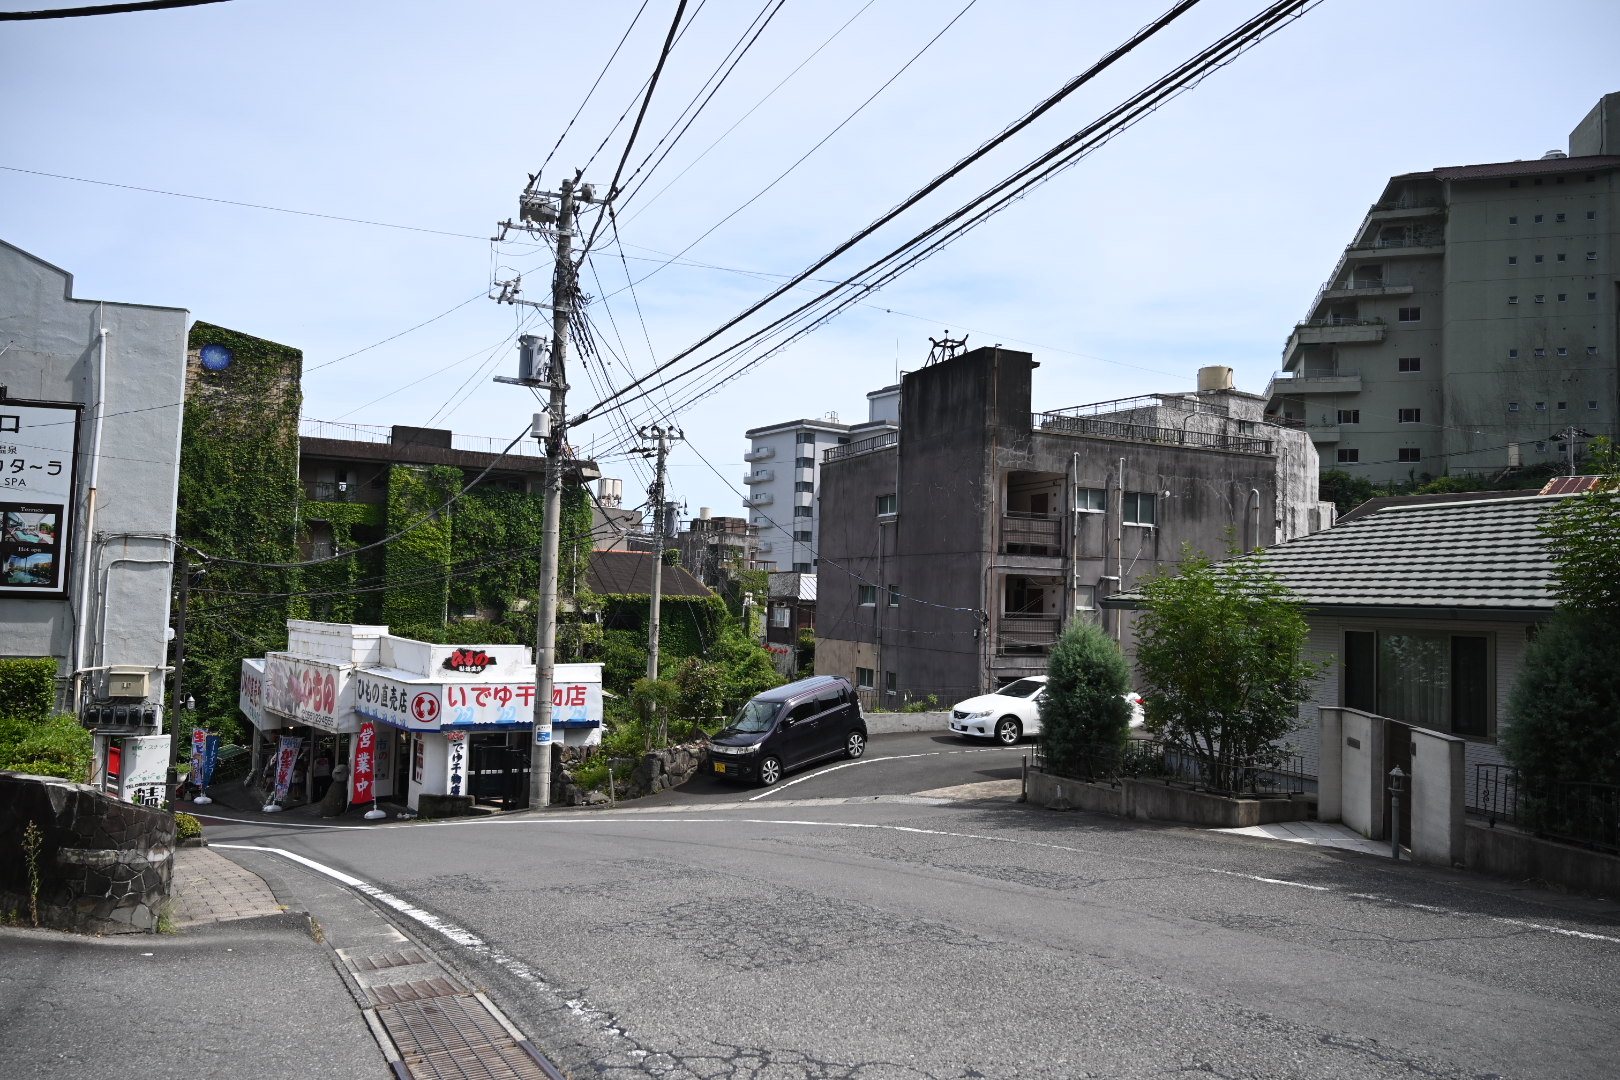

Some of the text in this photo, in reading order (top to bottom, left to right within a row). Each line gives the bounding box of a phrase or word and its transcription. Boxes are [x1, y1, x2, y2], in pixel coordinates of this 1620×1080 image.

[4, 477, 27, 487] SPA
[451, 650, 489, 668] ひもの
[302, 668, 336, 715] ひもの
[357, 678, 408, 714] ひもの直売店
[355, 727, 374, 798] 営業中
[450, 740, 464, 796] でゆ干物店
